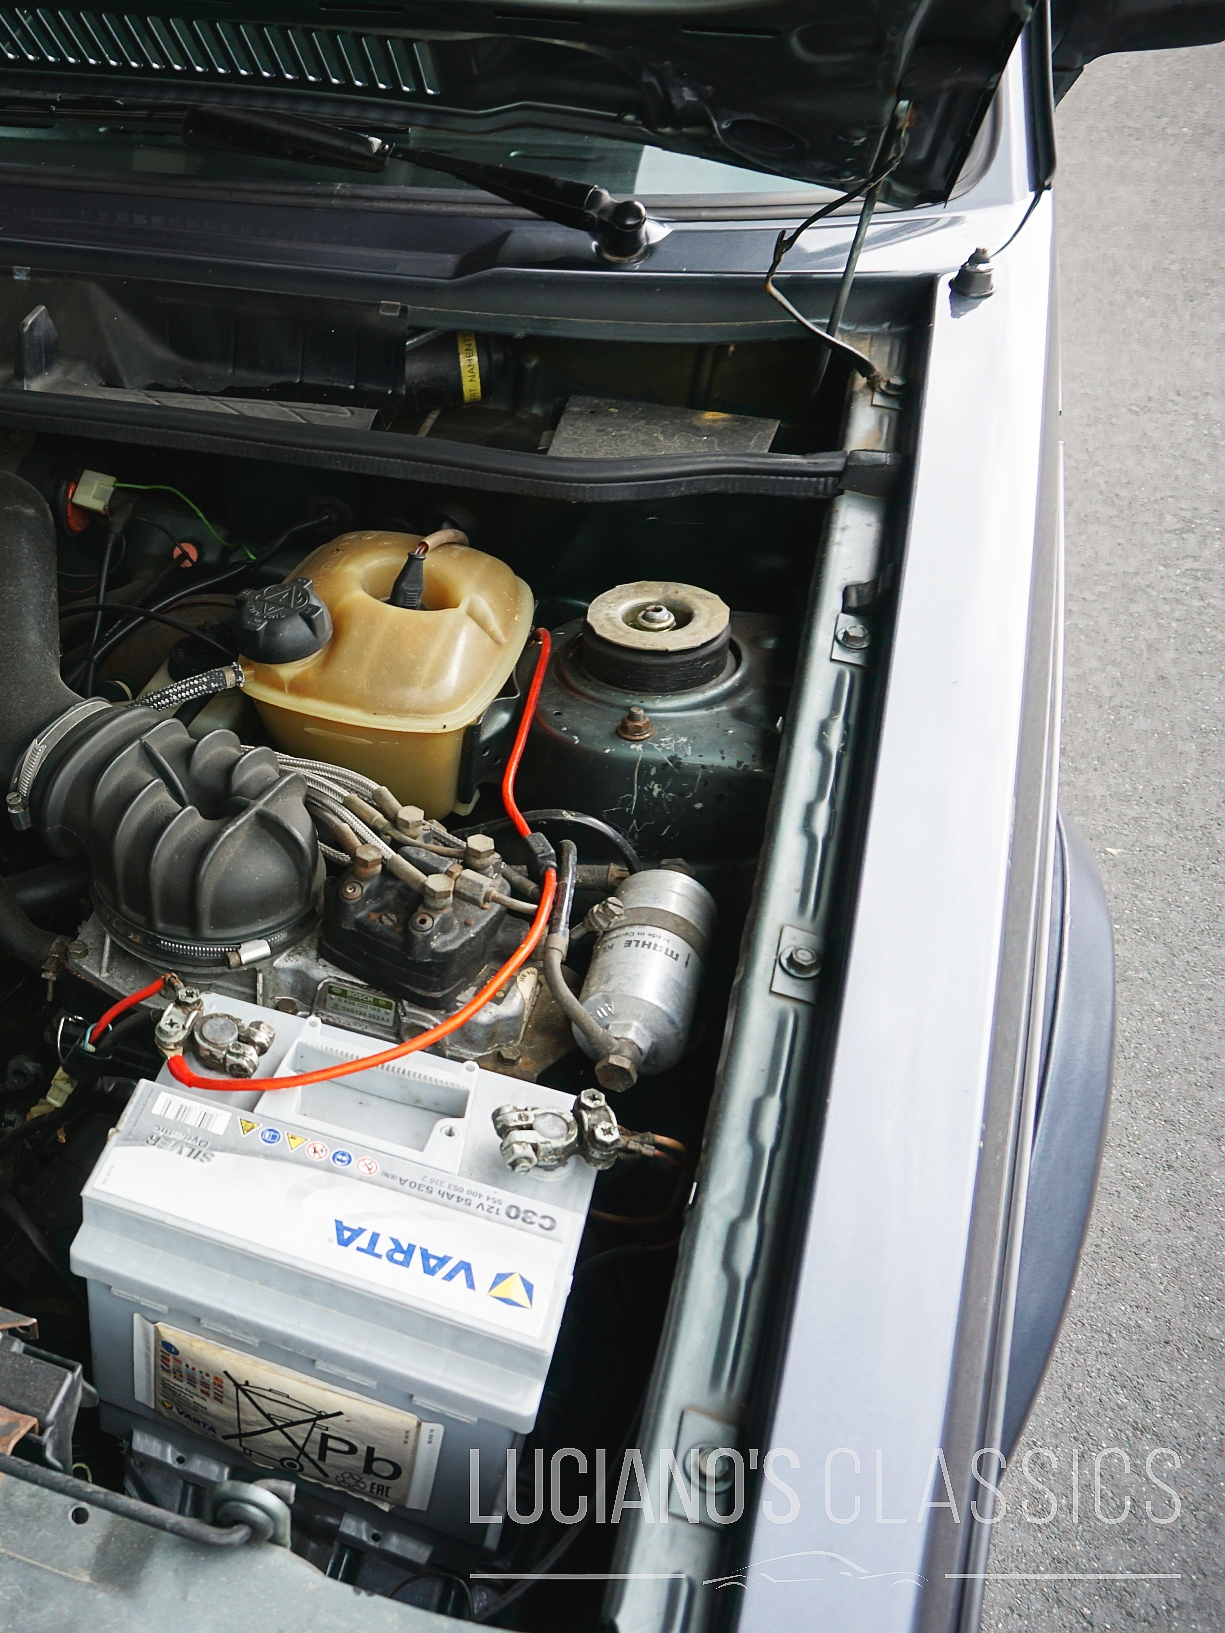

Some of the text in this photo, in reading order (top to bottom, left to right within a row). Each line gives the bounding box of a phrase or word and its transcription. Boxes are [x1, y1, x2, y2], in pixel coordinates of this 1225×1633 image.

[623, 939, 680, 961] MAHLE
[347, 990, 374, 1003] BOSCH
[145, 1134, 215, 1163] SILVER
[437, 1189, 473, 1207] 54Ah
[466, 1189, 483, 1199] 400
[475, 1202, 501, 1216] 12V
[505, 1204, 557, 1232] C30
[334, 1218, 476, 1291] VARTA
[176, 1407, 216, 1434] VARTA
[318, 1432, 403, 1481] Pb
